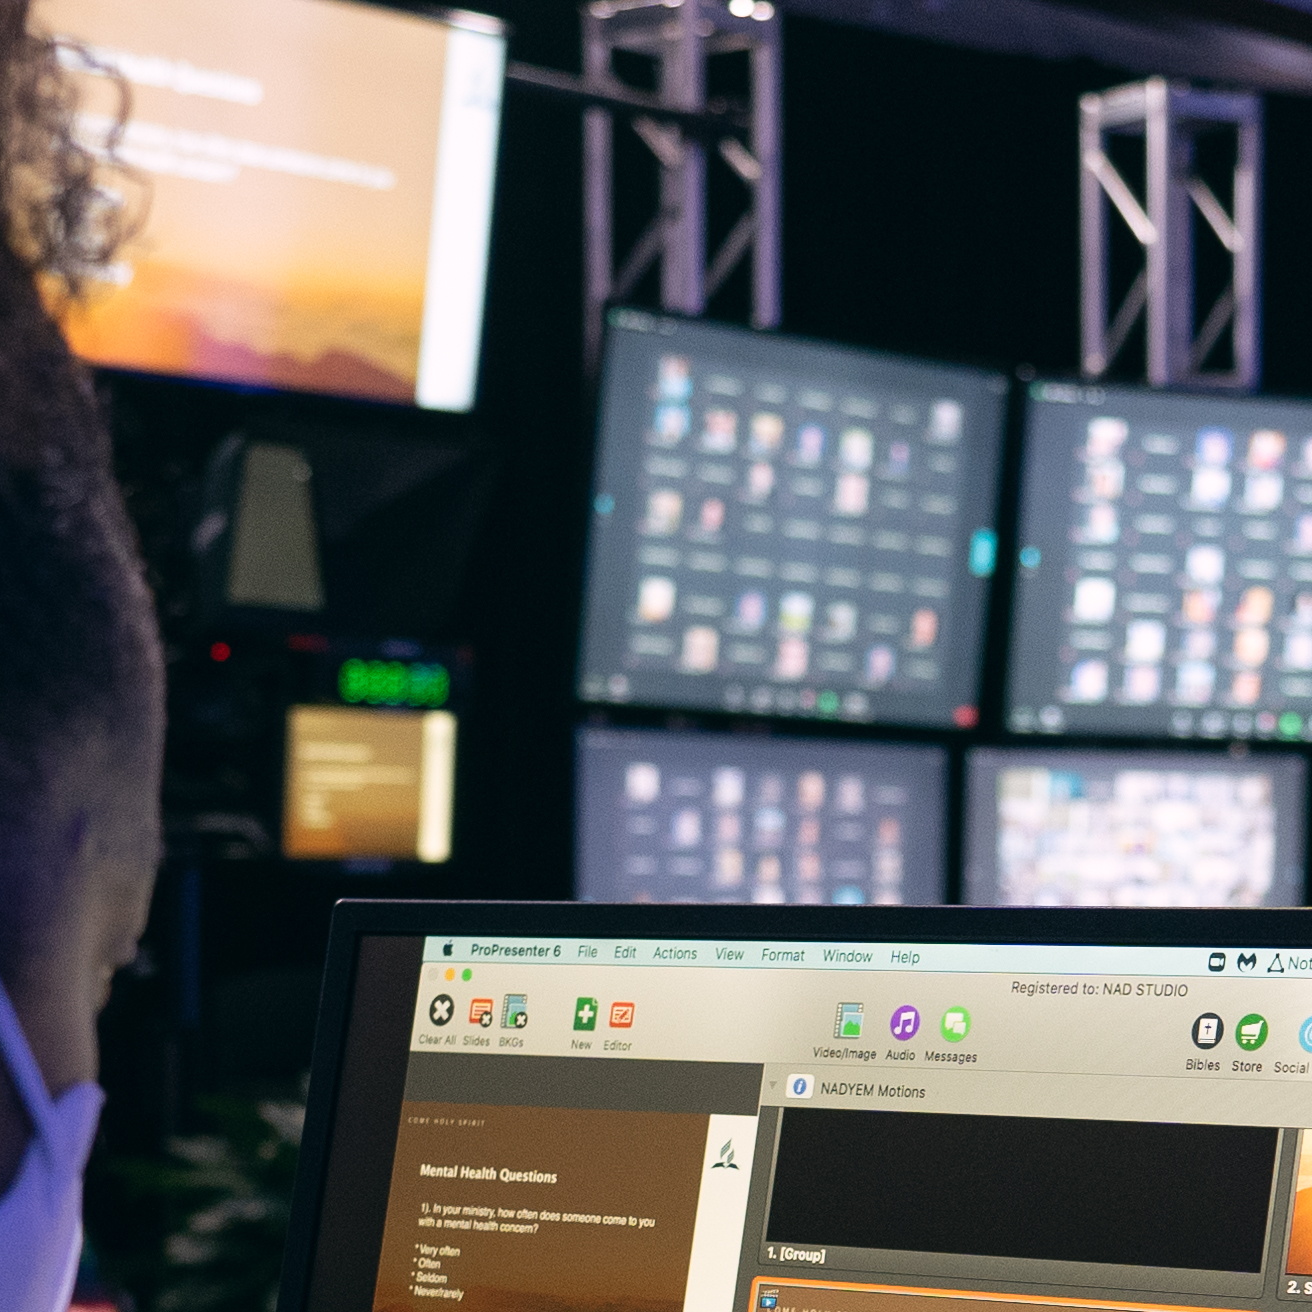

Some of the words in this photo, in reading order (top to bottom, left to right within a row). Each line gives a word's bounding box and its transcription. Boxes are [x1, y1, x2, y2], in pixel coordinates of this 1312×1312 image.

[470, 943, 552, 957] ProPresenter
[552, 945, 562, 958] 6
[577, 944, 598, 958] File
[613, 944, 636, 959] Edit
[653, 946, 697, 960] Actions
[715, 947, 744, 960] View
[761, 947, 805, 961] Format
[823, 949, 872, 962] Window
[890, 950, 920, 965] Help
[1287, 956, 1312, 970] Not
[1011, 980, 1078, 997] Registered
[1082, 982, 1099, 995] to:
[1102, 982, 1132, 996] NAD
[1135, 982, 1188, 997] STUDIO
[418, 1033, 442, 1045] Clear
[443, 1034, 456, 1045] All
[462, 1034, 490, 1047] Slides
[498, 1036, 524, 1048] BKGs
[570, 1038, 591, 1050] New
[602, 1039, 632, 1051] Editor
[813, 1047, 876, 1061] Video/Image
[884, 1049, 915, 1061] Audio
[924, 1050, 977, 1065] Messages
[1185, 1058, 1220, 1071] Bibles
[1231, 1059, 1262, 1072] Store
[1273, 1060, 1309, 1074] Social
[820, 1081, 874, 1096] NADYEM
[877, 1084, 925, 1098] Motions
[766, 1245, 777, 1259] 1.
[779, 1246, 826, 1264] [Group]
[1286, 1279, 1300, 1294] 2.
